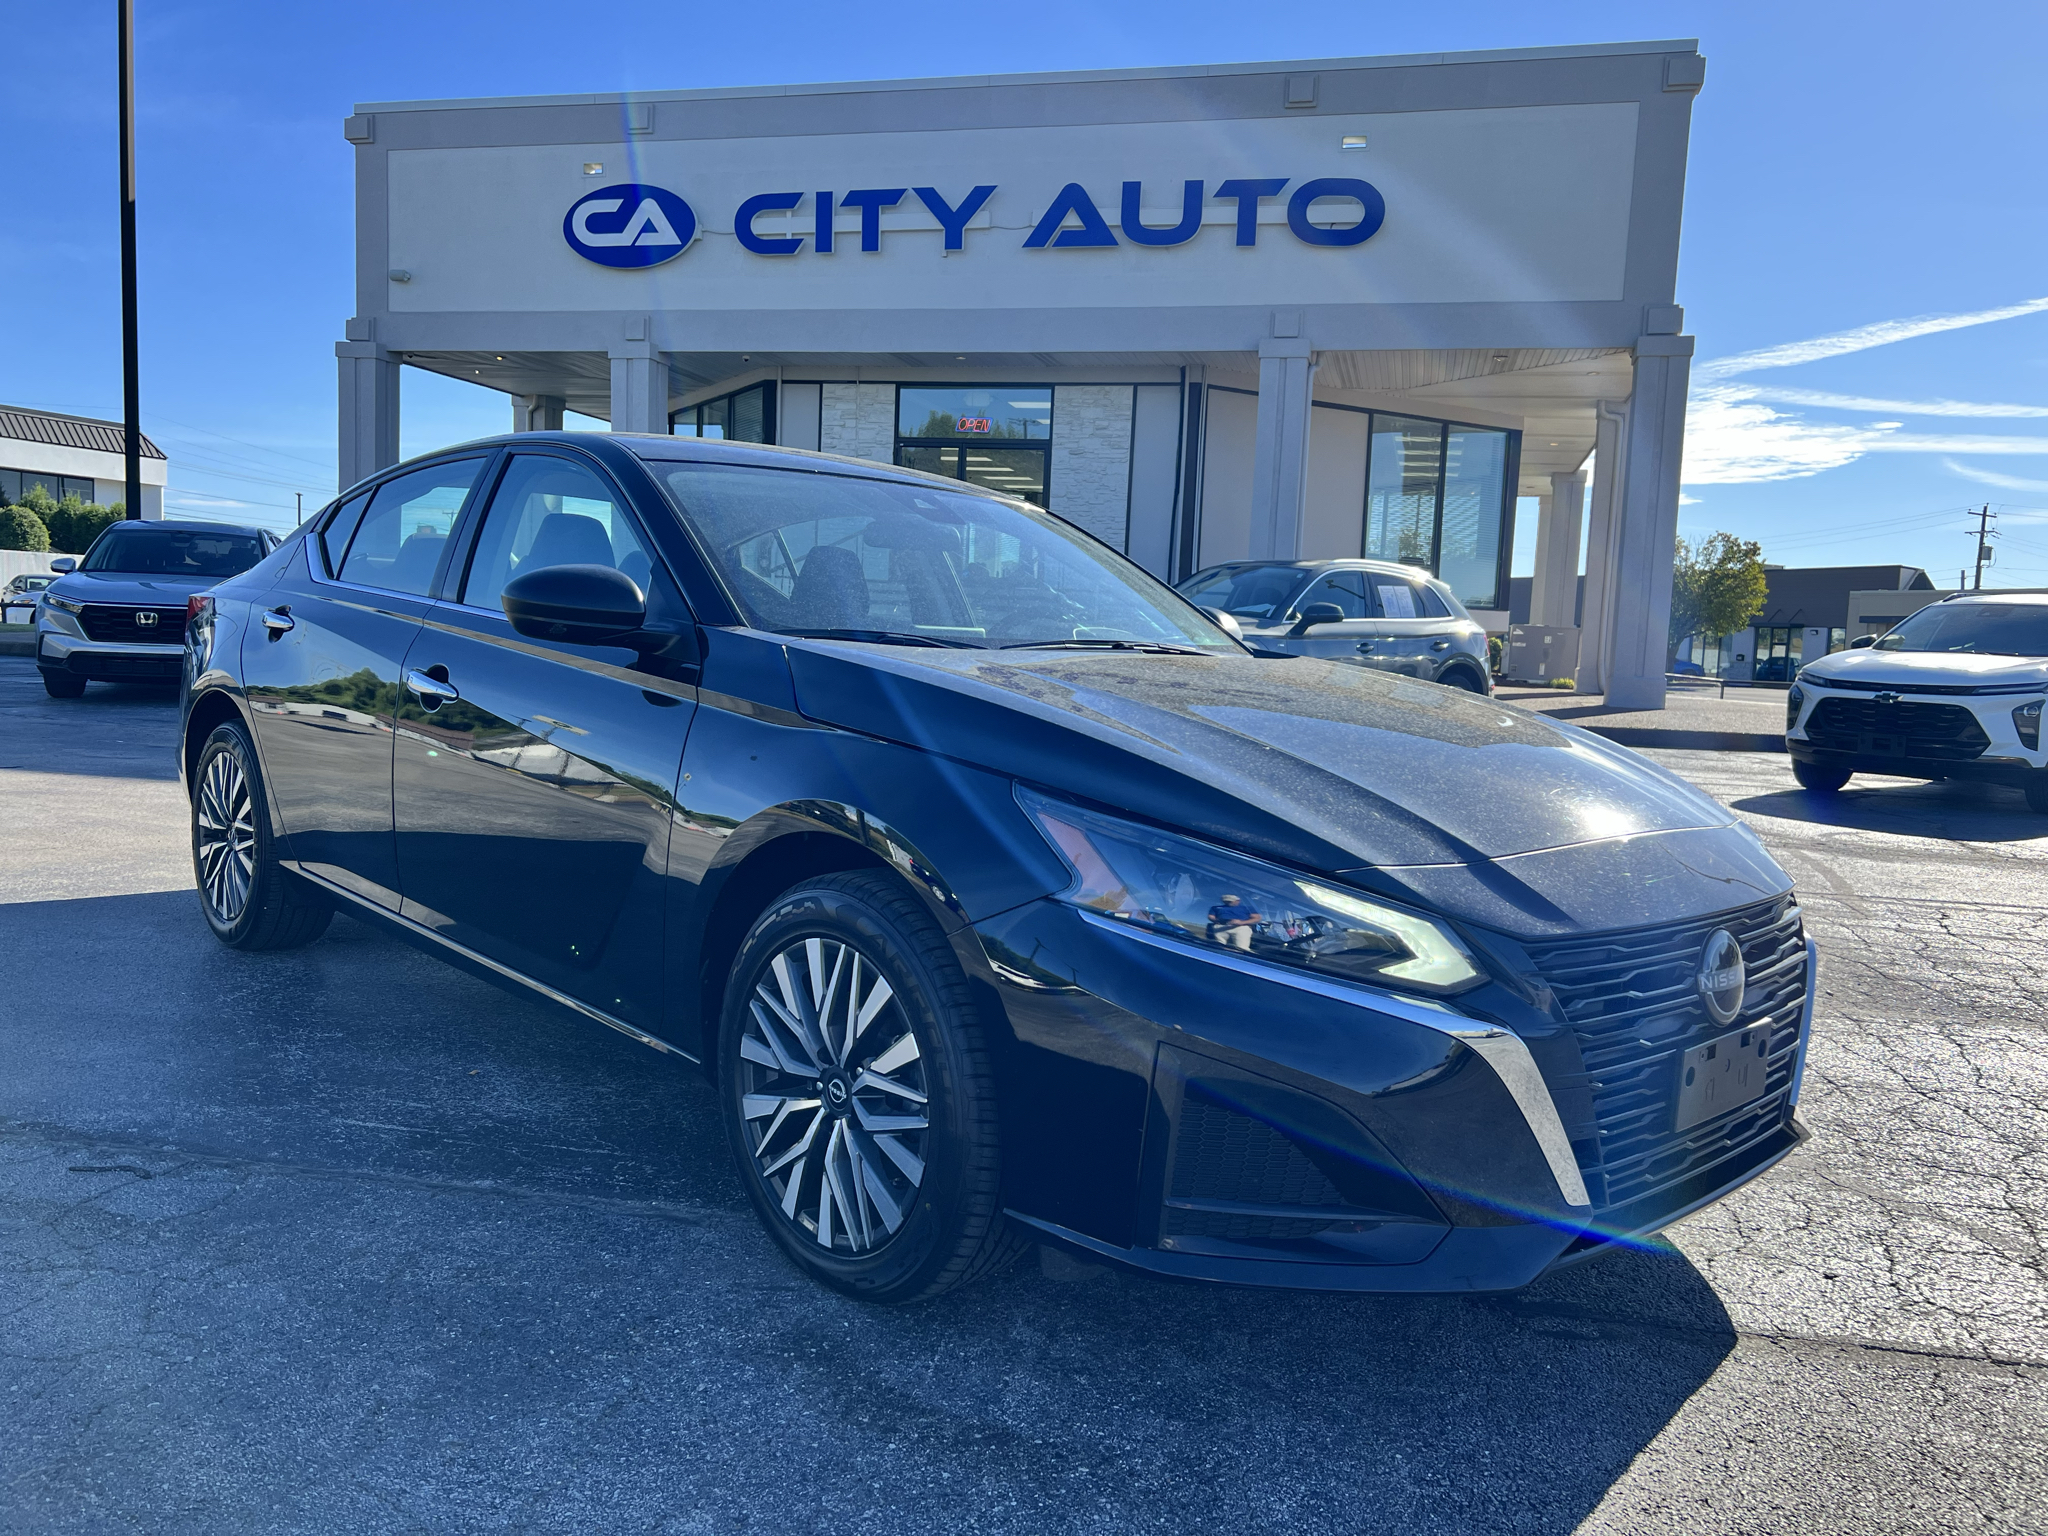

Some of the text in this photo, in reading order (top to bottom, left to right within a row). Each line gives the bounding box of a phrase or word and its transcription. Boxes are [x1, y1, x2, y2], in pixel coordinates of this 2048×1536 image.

[572, 198, 682, 247] CA
[734, 177, 1385, 255] CITY AUTO
[958, 418, 991, 432] OPEN
[1700, 969, 1739, 990] NISS
